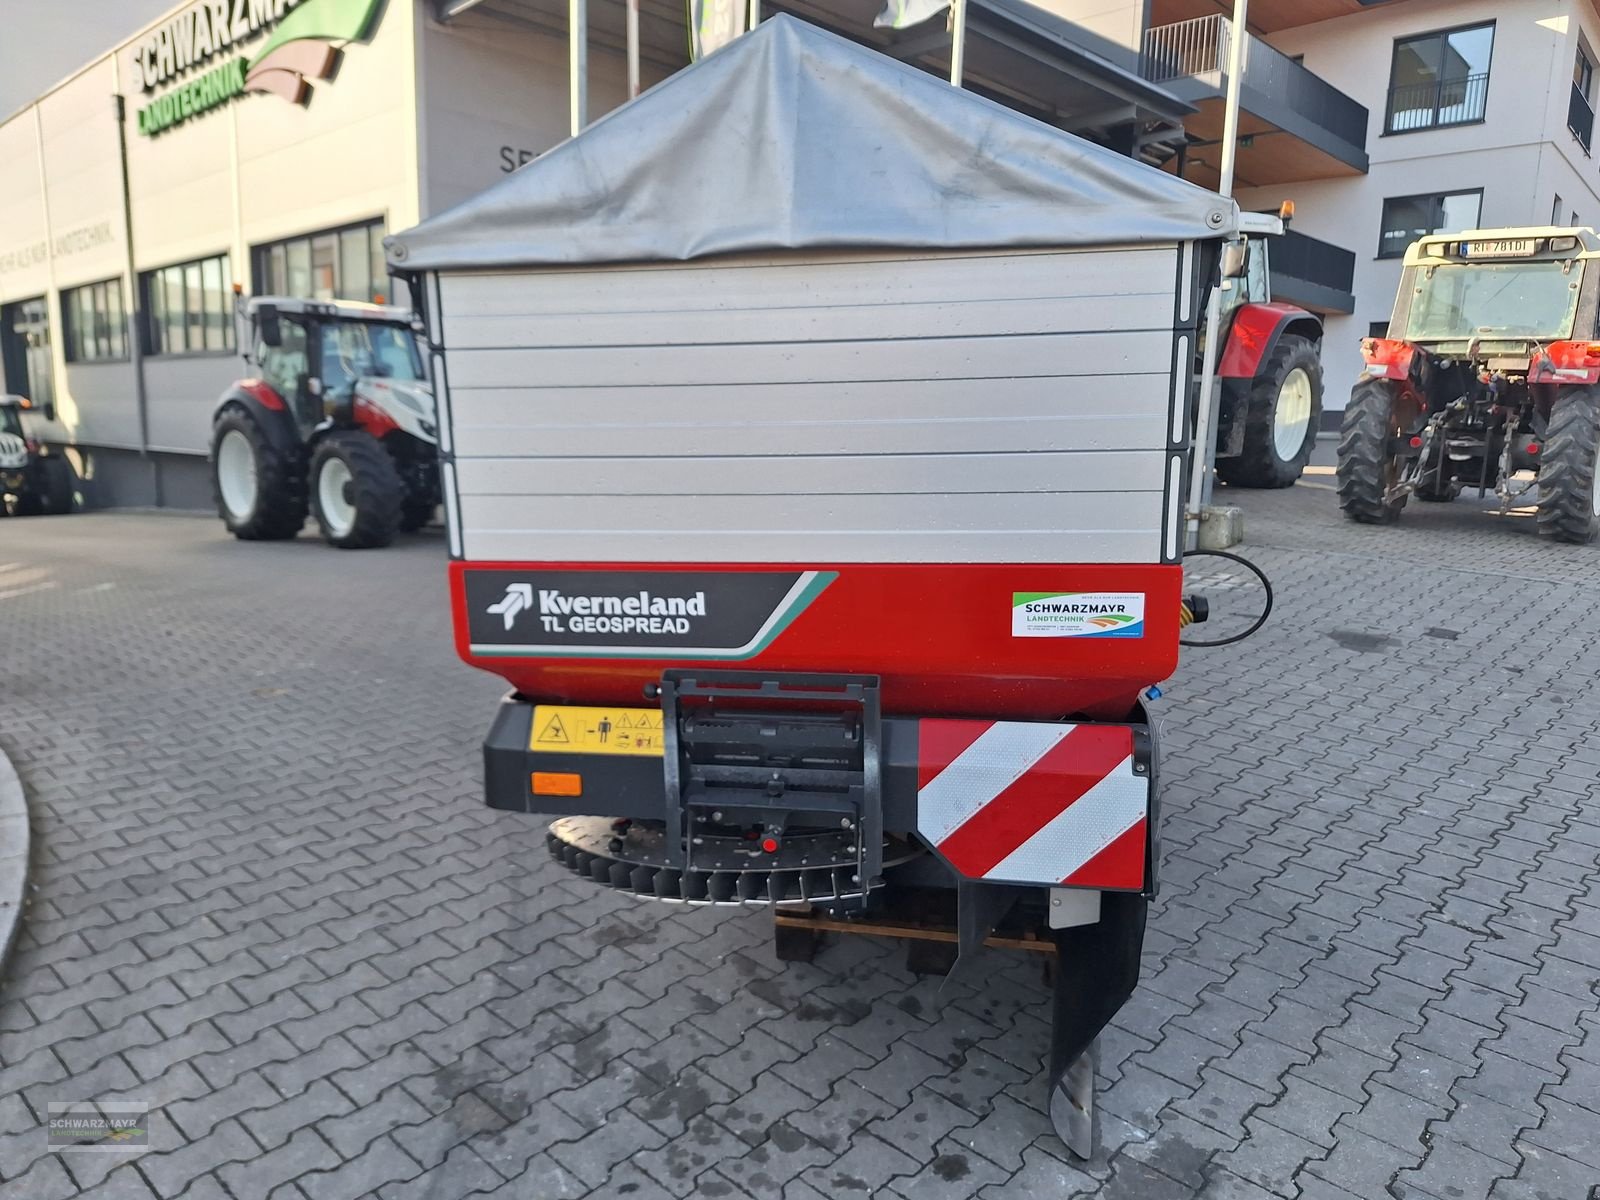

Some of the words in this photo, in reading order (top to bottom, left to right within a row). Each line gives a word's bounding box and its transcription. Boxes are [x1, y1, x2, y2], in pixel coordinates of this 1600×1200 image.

[132, 0, 299, 91] SCHWARZM
[137, 57, 248, 135] LANDTECHNIK
[499, 146, 541, 173] SE
[539, 590, 706, 616] Kverneland
[1025, 603, 1126, 614] SCHWARZMAYR
[540, 616, 565, 632] TL
[568, 616, 690, 634] GEOSPREAD
[1026, 615, 1085, 623] LANDTECHNIK
